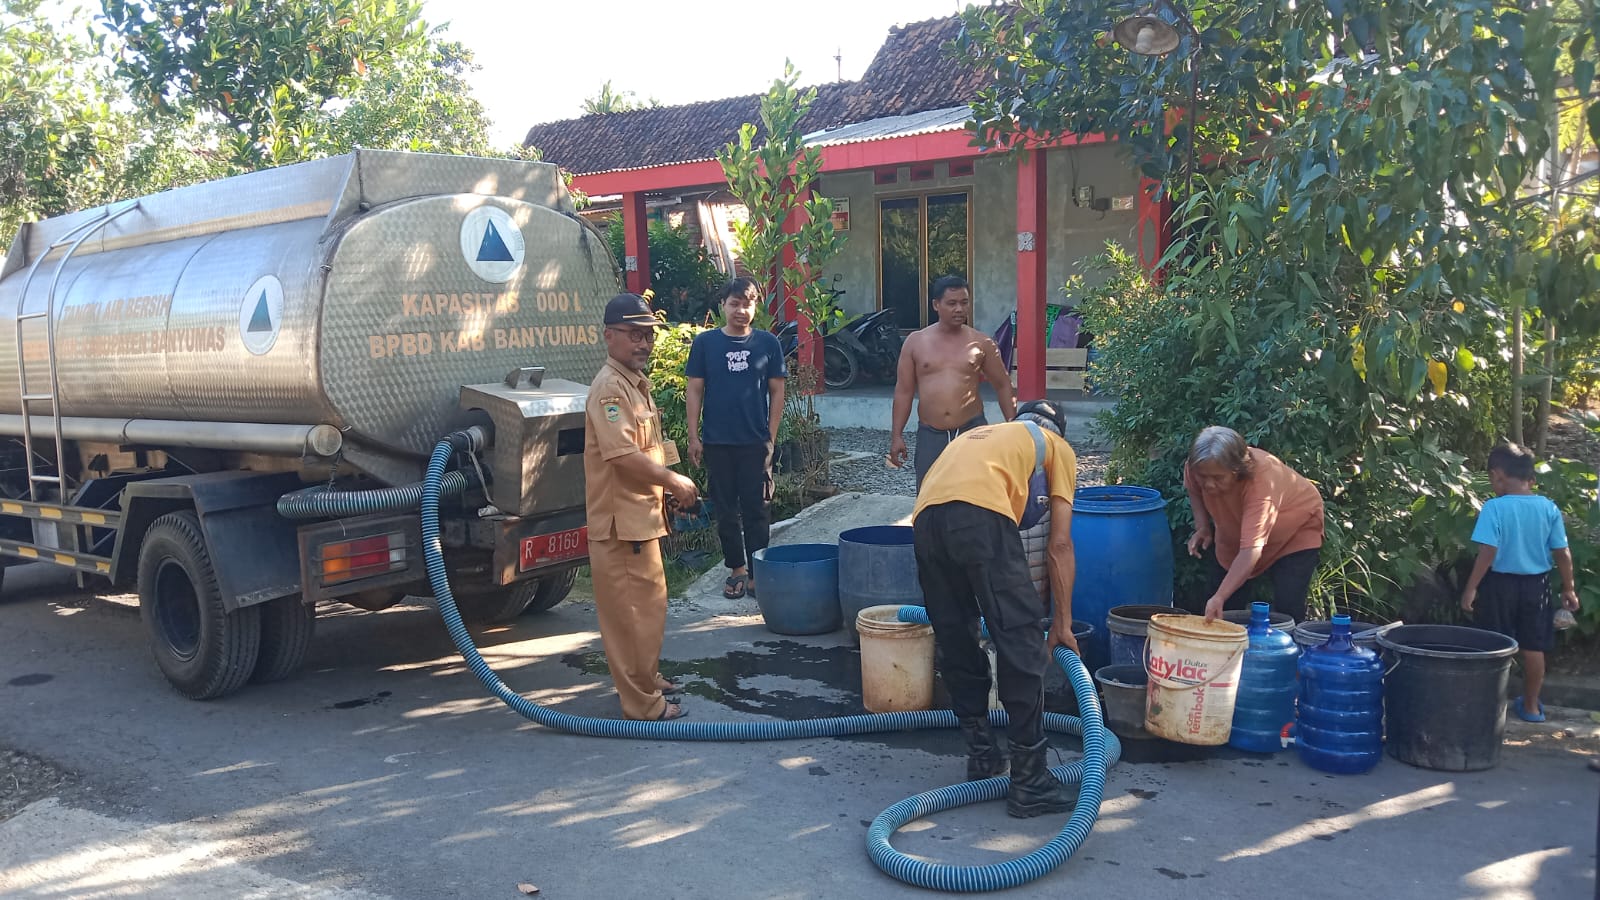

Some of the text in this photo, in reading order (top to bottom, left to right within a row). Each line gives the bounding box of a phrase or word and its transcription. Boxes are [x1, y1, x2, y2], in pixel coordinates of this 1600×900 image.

[127, 295, 172, 317] BERSIH
[402, 292, 520, 316] KAPASITAS
[151, 326, 225, 353] BANYUMAS
[369, 325, 599, 359] BPBD KAB BANYUMAS
[525, 531, 580, 559] R 8160
[1188, 688, 1205, 734] Tembok
